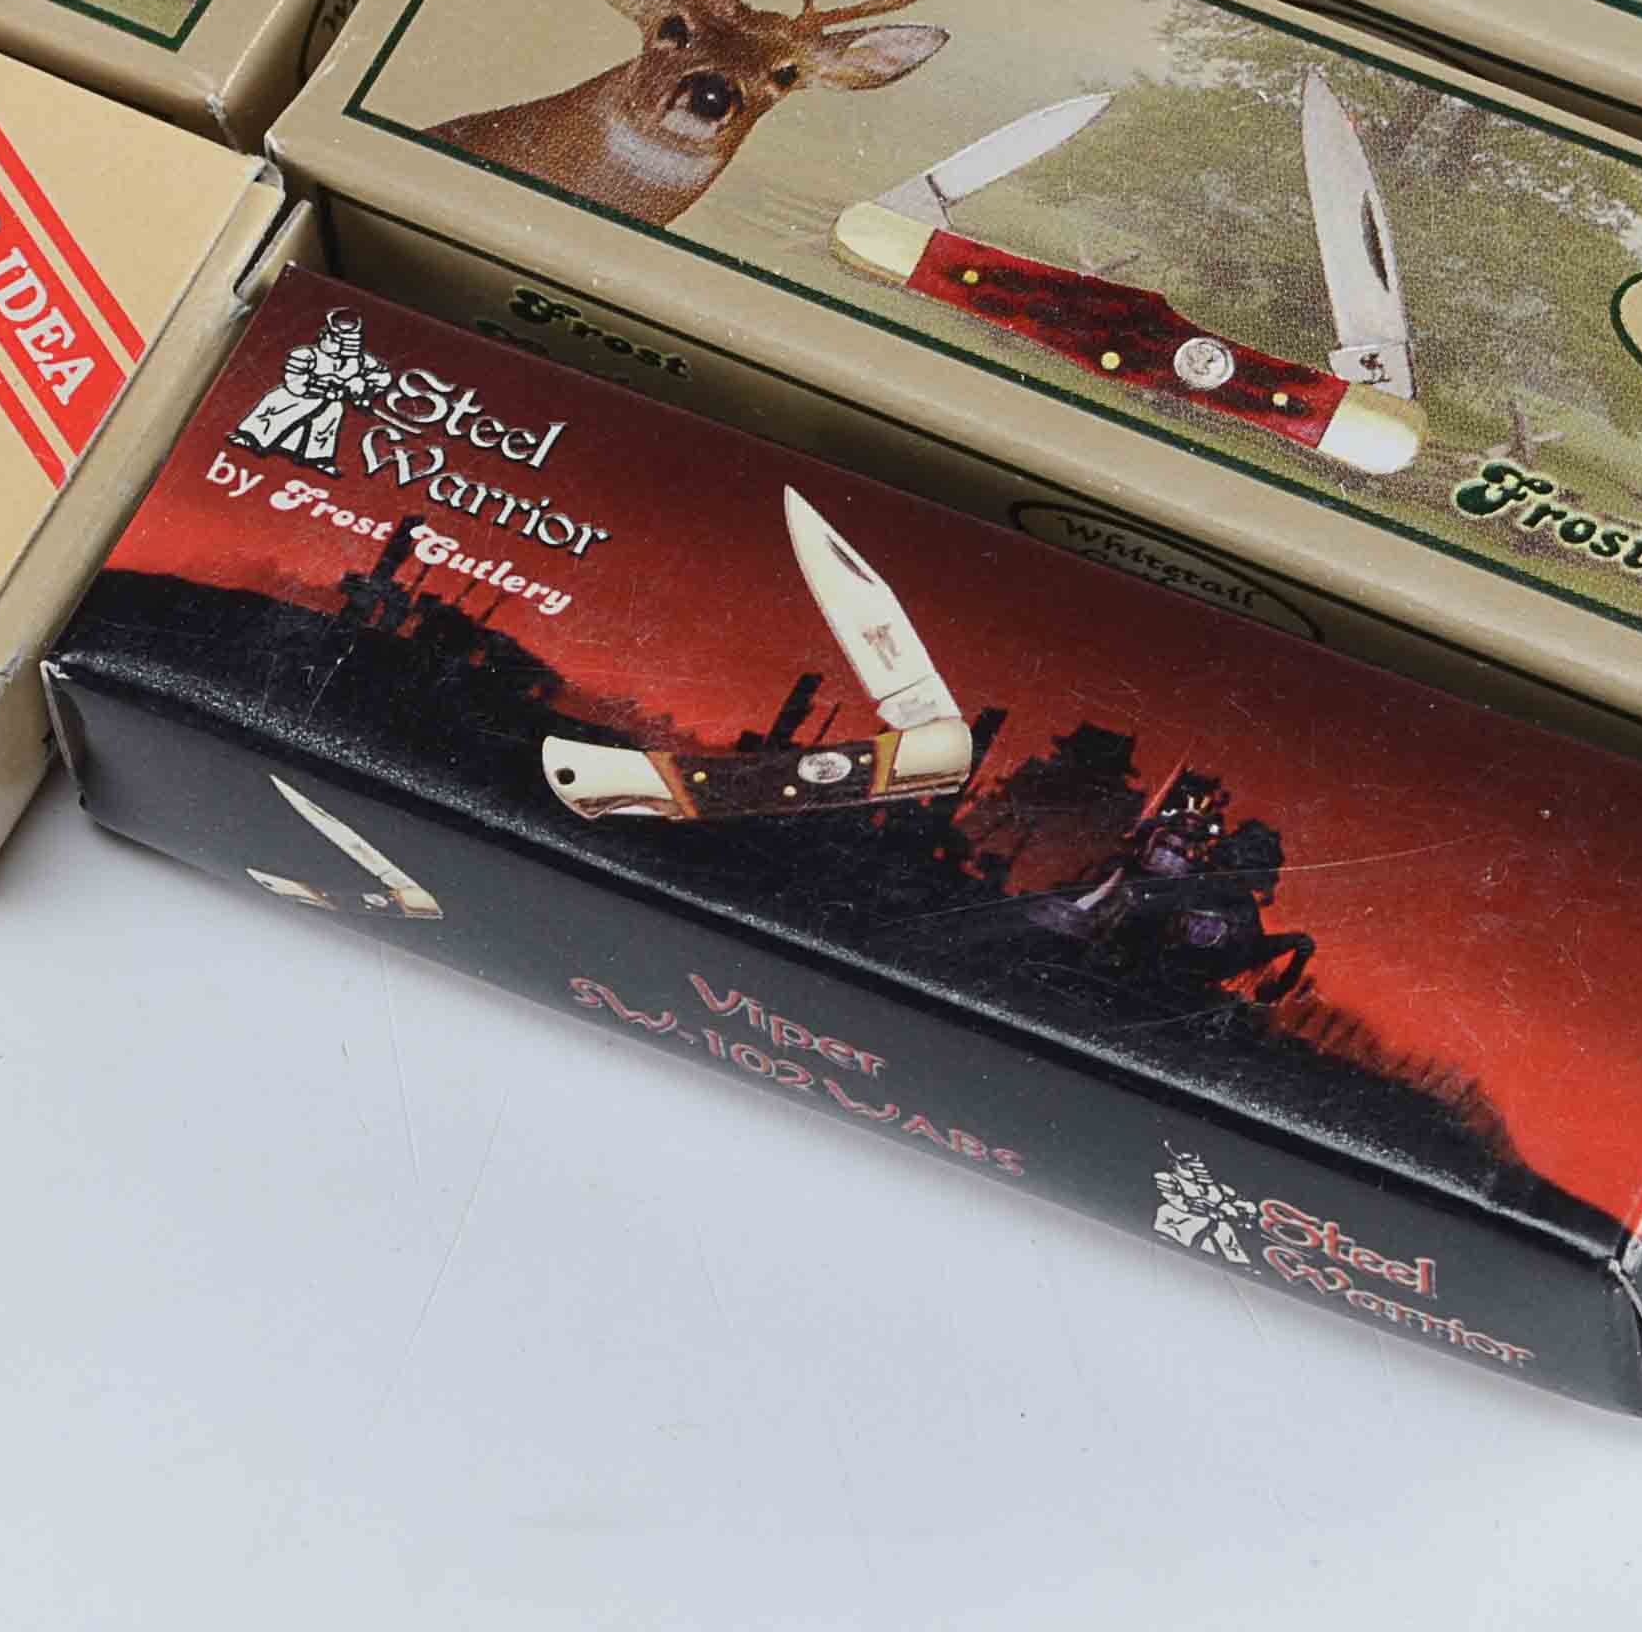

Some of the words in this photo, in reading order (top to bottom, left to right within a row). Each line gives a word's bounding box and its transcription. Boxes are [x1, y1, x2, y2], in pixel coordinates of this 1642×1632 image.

[509, 284, 692, 381] Frost
[384, 368, 565, 470] Steel
[207, 451, 264, 497] by
[270, 479, 392, 543] Frost
[409, 522, 574, 617] Cutlery
[361, 425, 610, 557] Warrior
[1057, 517, 1263, 609] Whitetail
[570, 977, 814, 1089] SW-102
[824, 1079, 1024, 1176] WABS
[689, 973, 885, 1078] Viper
[1259, 1200, 1437, 1298] Steel
[1263, 1246, 1536, 1367] Warrior
